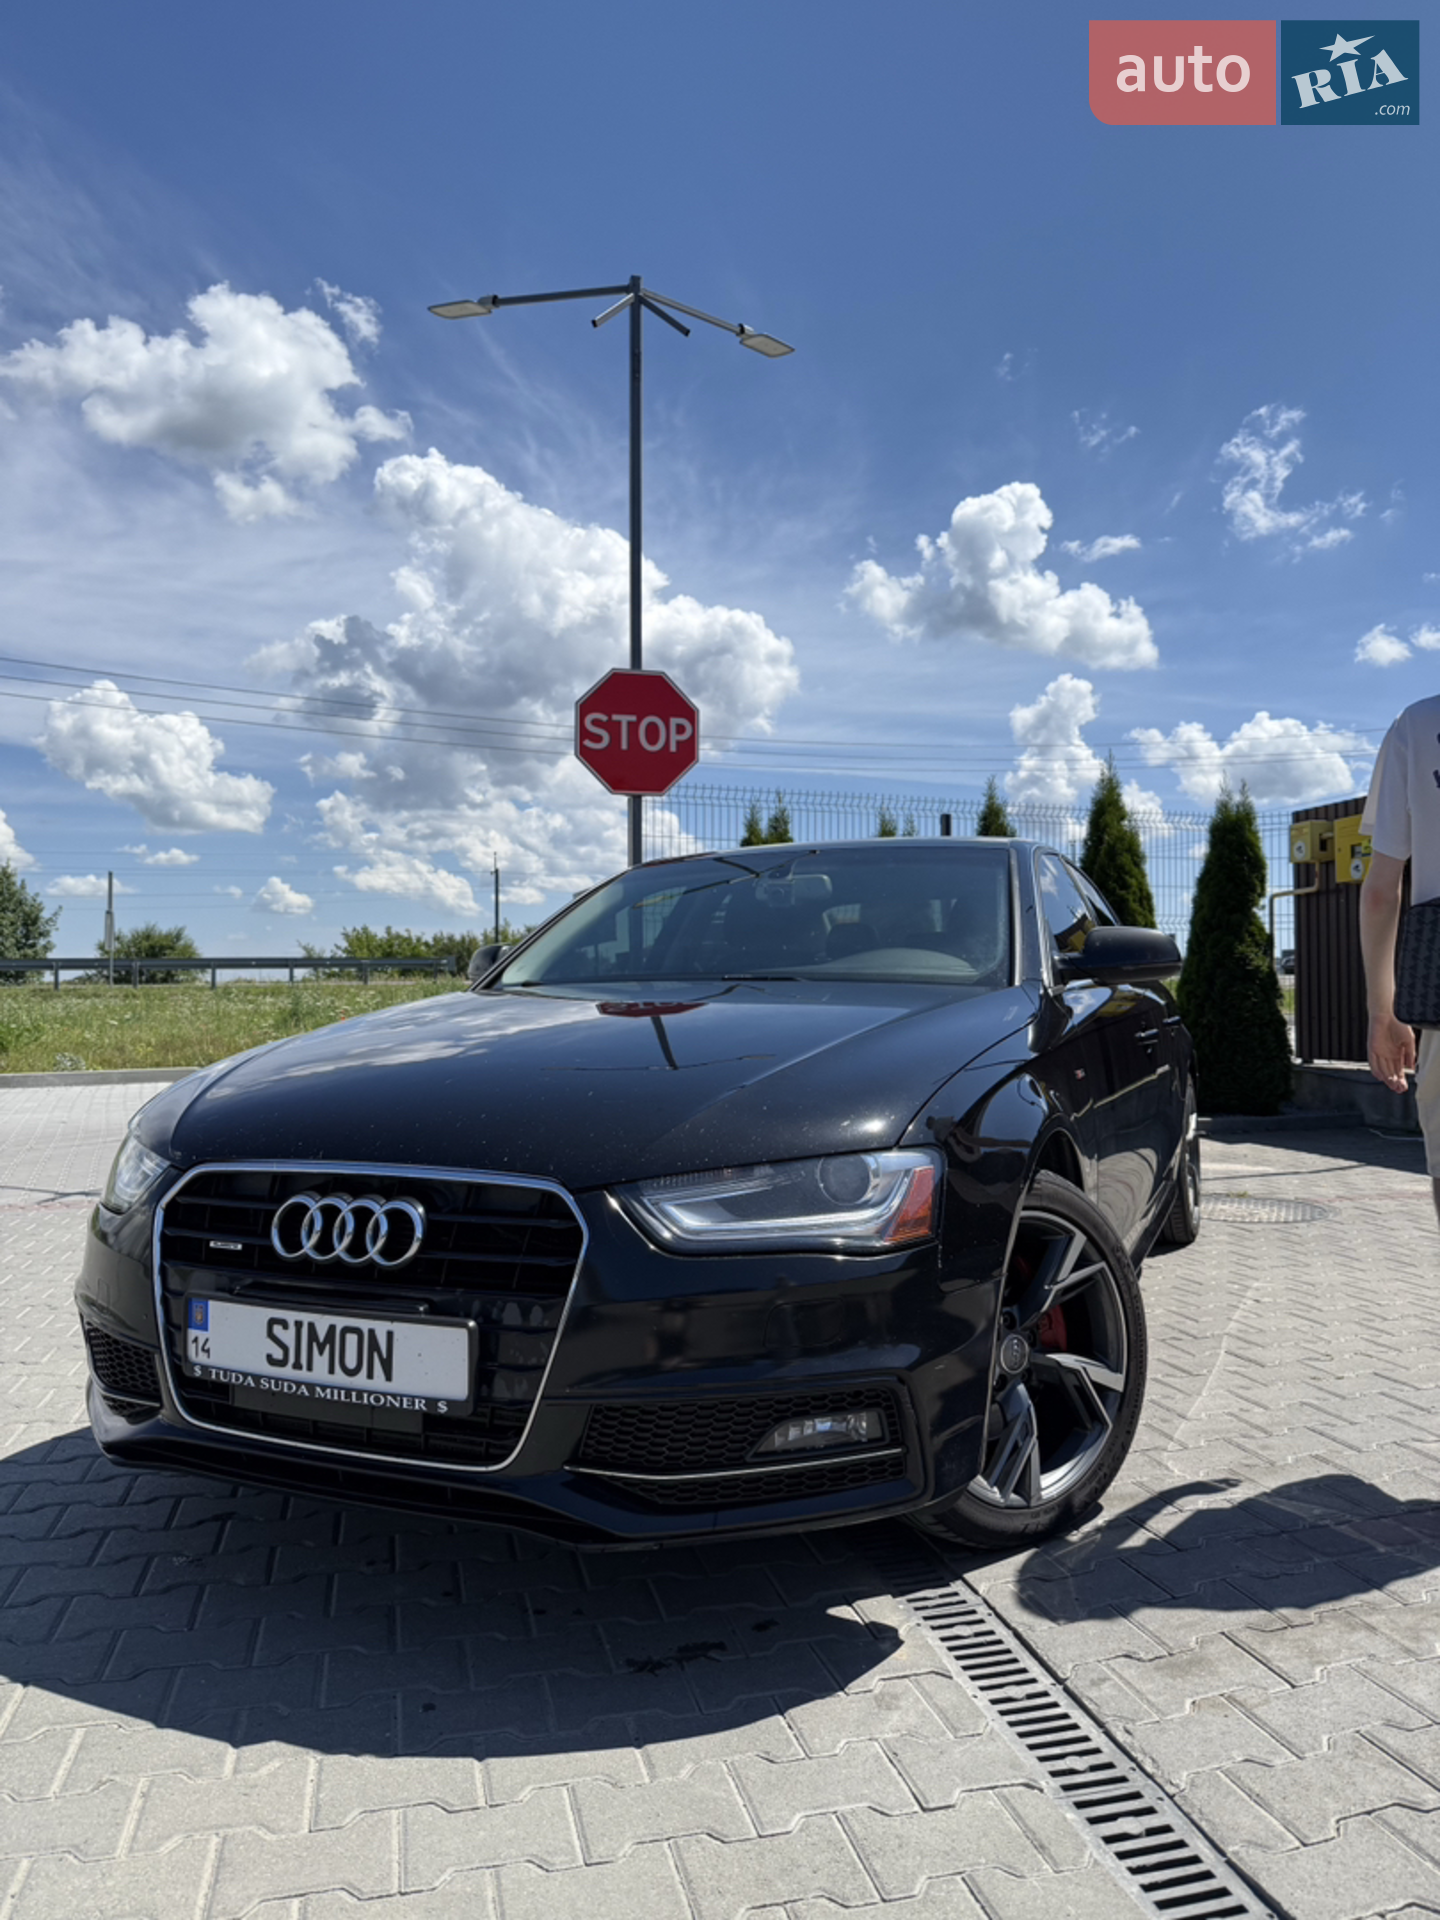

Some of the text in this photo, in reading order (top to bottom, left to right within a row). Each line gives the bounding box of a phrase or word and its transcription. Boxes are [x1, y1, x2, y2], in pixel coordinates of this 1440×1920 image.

[582, 712, 693, 753] STOP
[191, 1335, 211, 1359] 14
[266, 1317, 394, 1382] SIMON
[208, 1368, 256, 1388] TUDA
[260, 1377, 309, 1397] SUDA
[314, 1385, 428, 1411] MILLIONER
